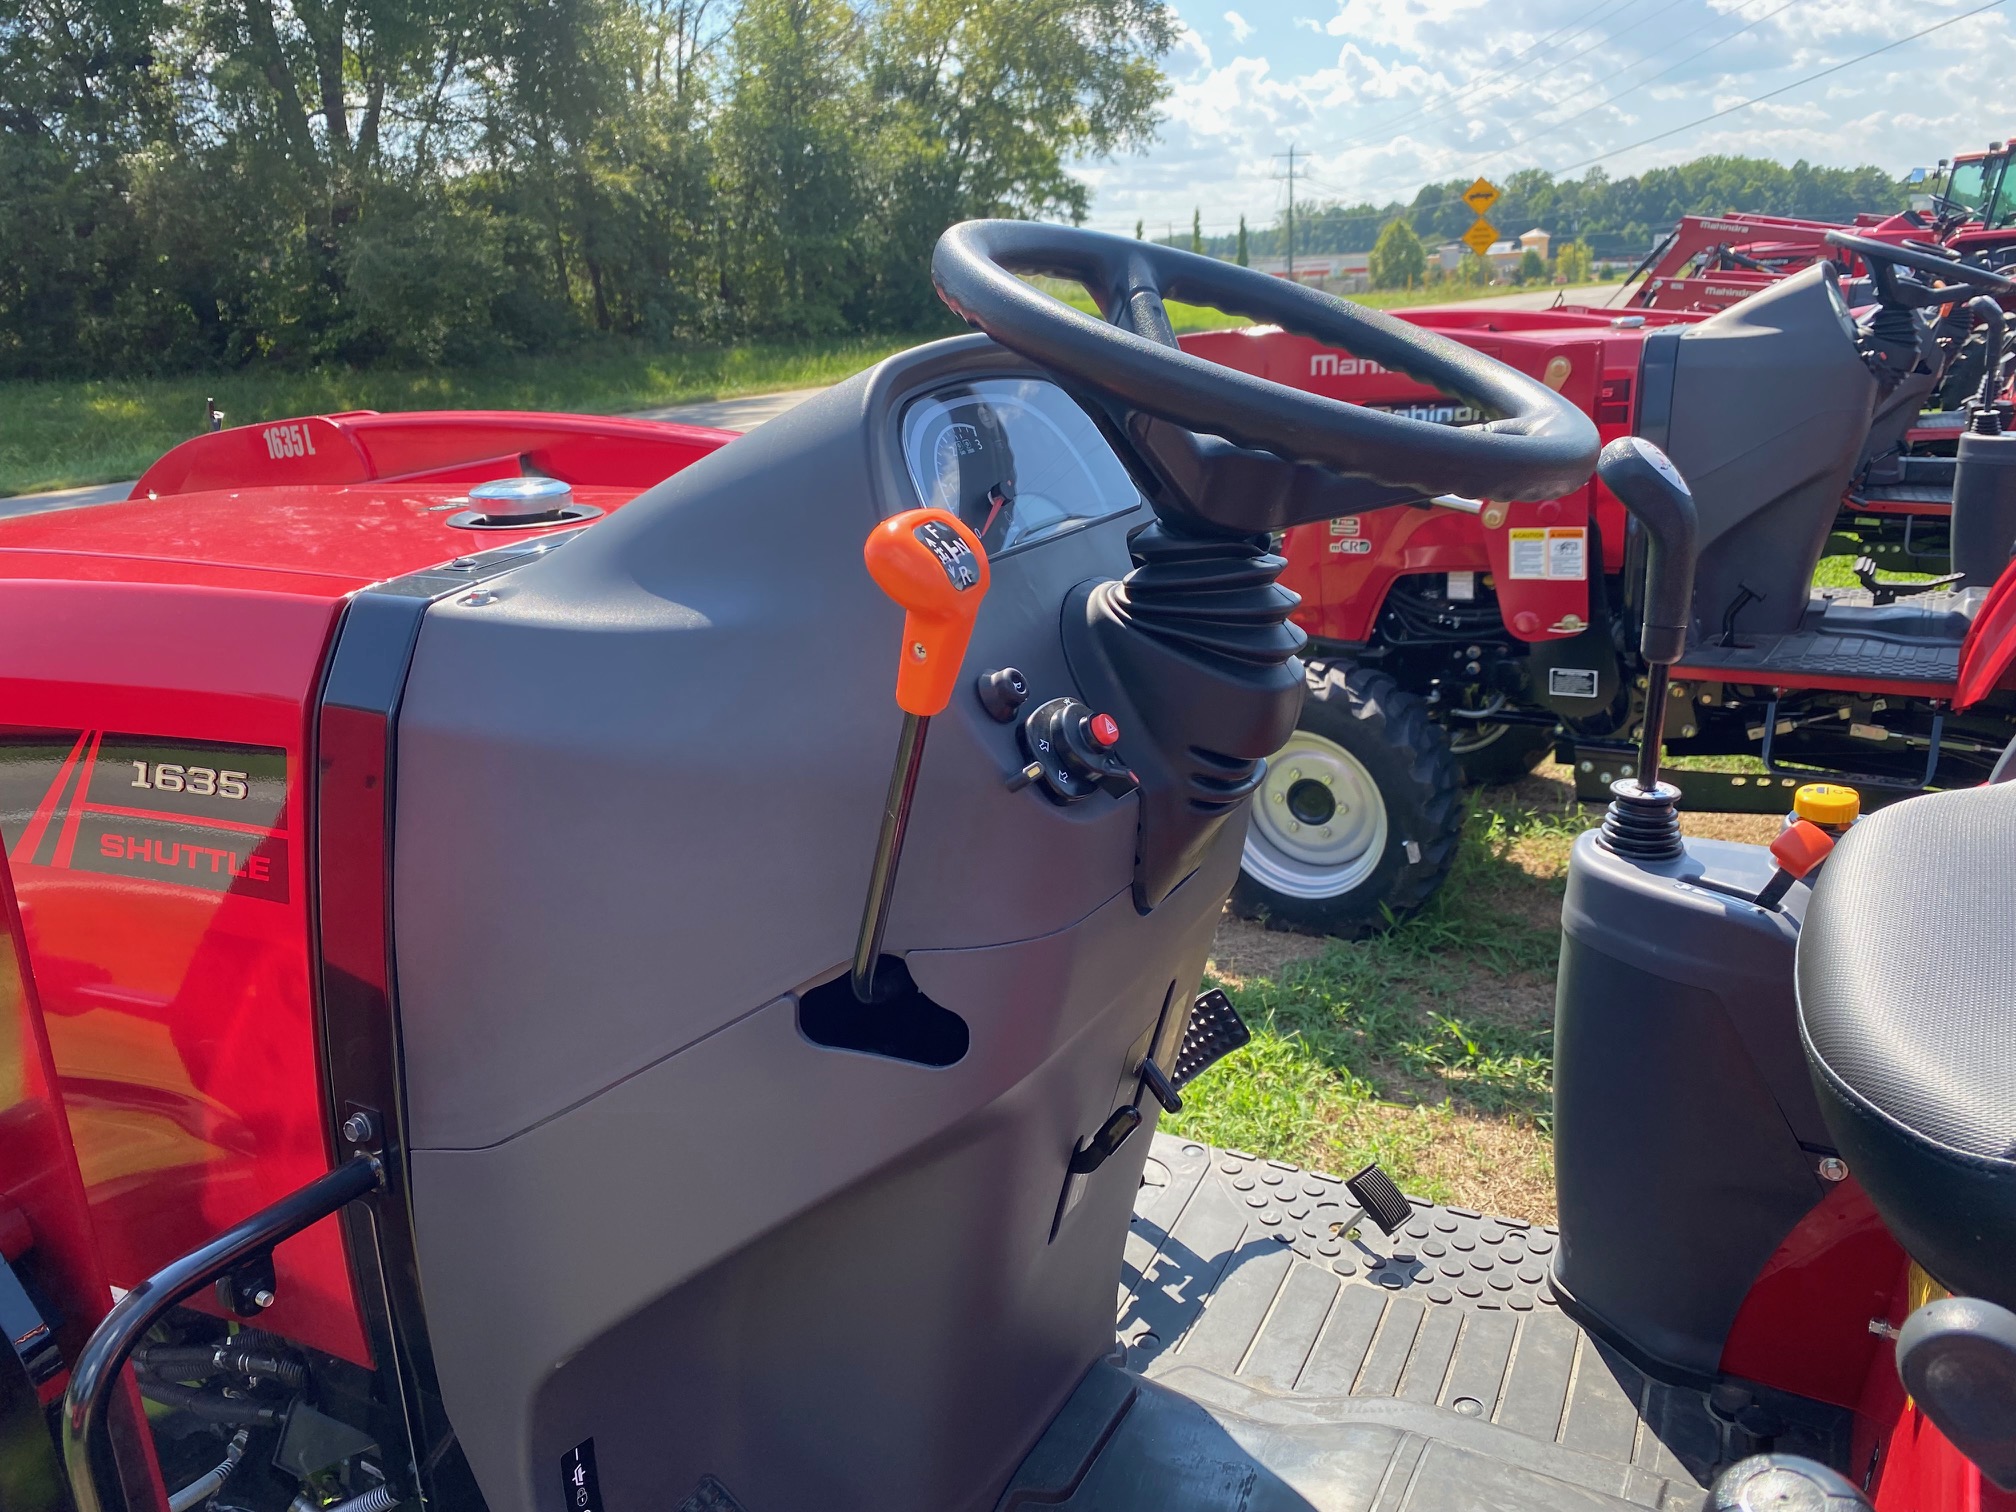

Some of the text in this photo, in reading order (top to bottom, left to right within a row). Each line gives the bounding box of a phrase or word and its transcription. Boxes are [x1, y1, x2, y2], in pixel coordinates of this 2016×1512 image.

[1700, 221, 1749, 233] Mahindra
[263, 425, 304, 460] 1635
[924, 524, 940, 539] F
[952, 537, 971, 556] N
[958, 566, 972, 585] R
[131, 760, 249, 800] 1635
[100, 833, 271, 882] SHUTTLE
